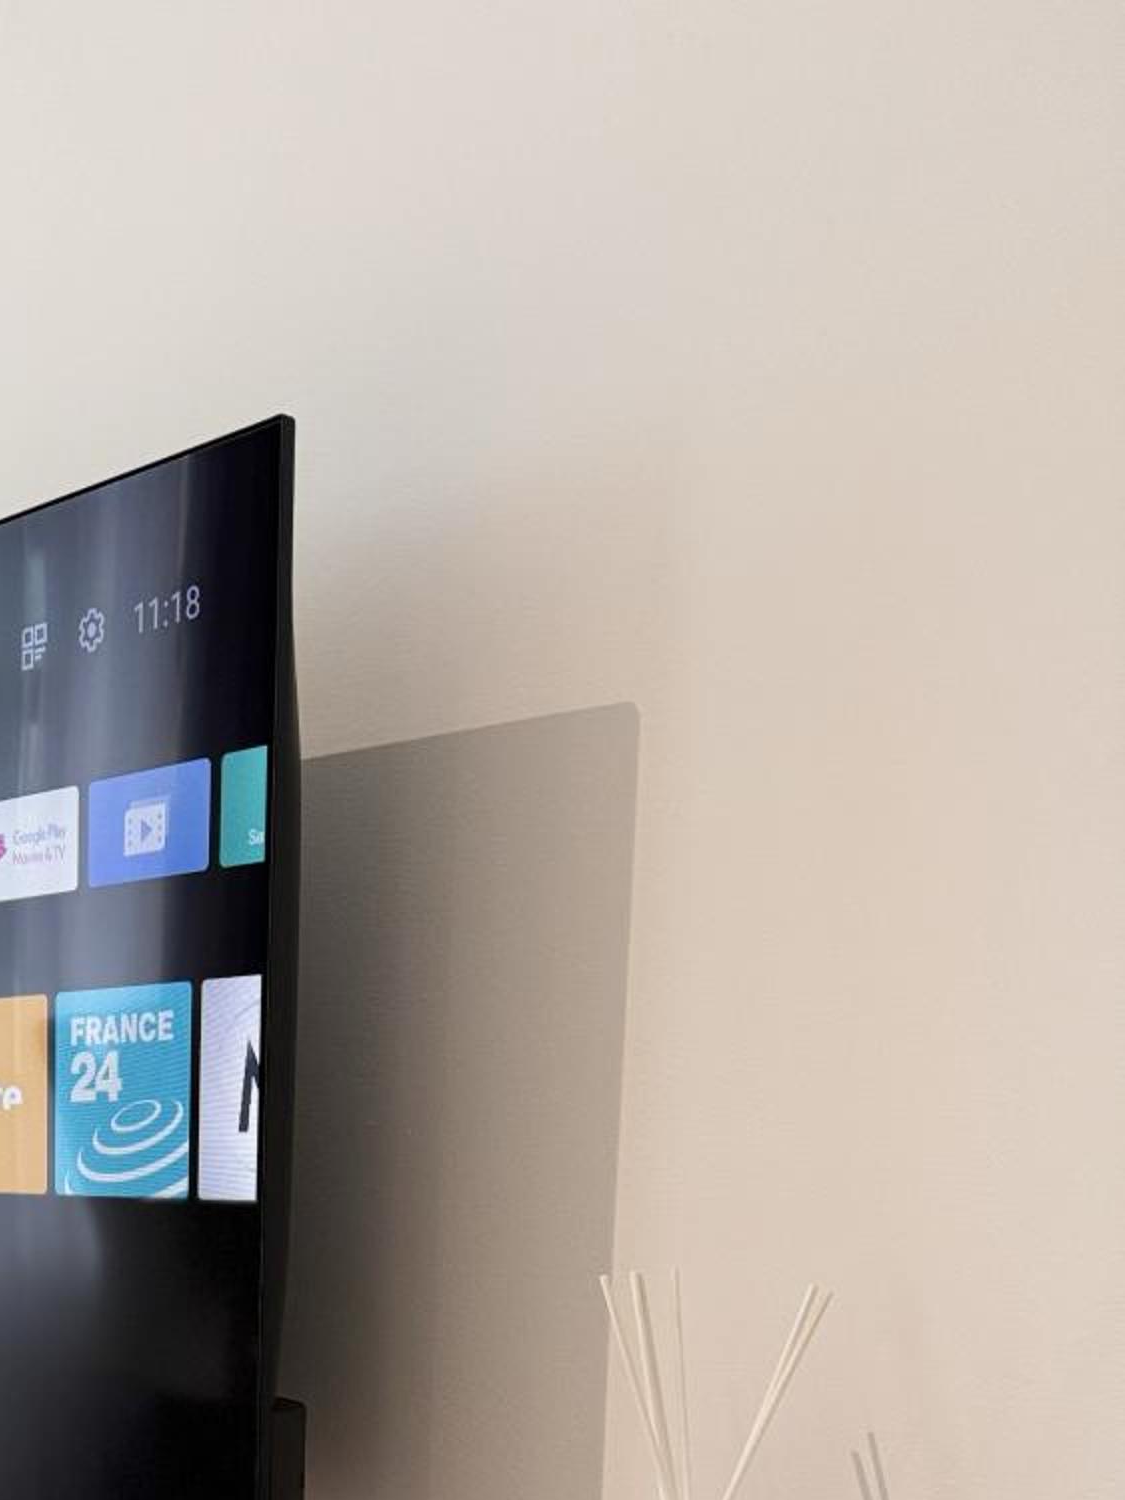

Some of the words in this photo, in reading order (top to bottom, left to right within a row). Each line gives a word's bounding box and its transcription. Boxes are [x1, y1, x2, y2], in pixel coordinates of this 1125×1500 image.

[133, 584, 201, 634] 11:18
[70, 1009, 174, 1047] FRANCE
[70, 1050, 123, 1101] 24
